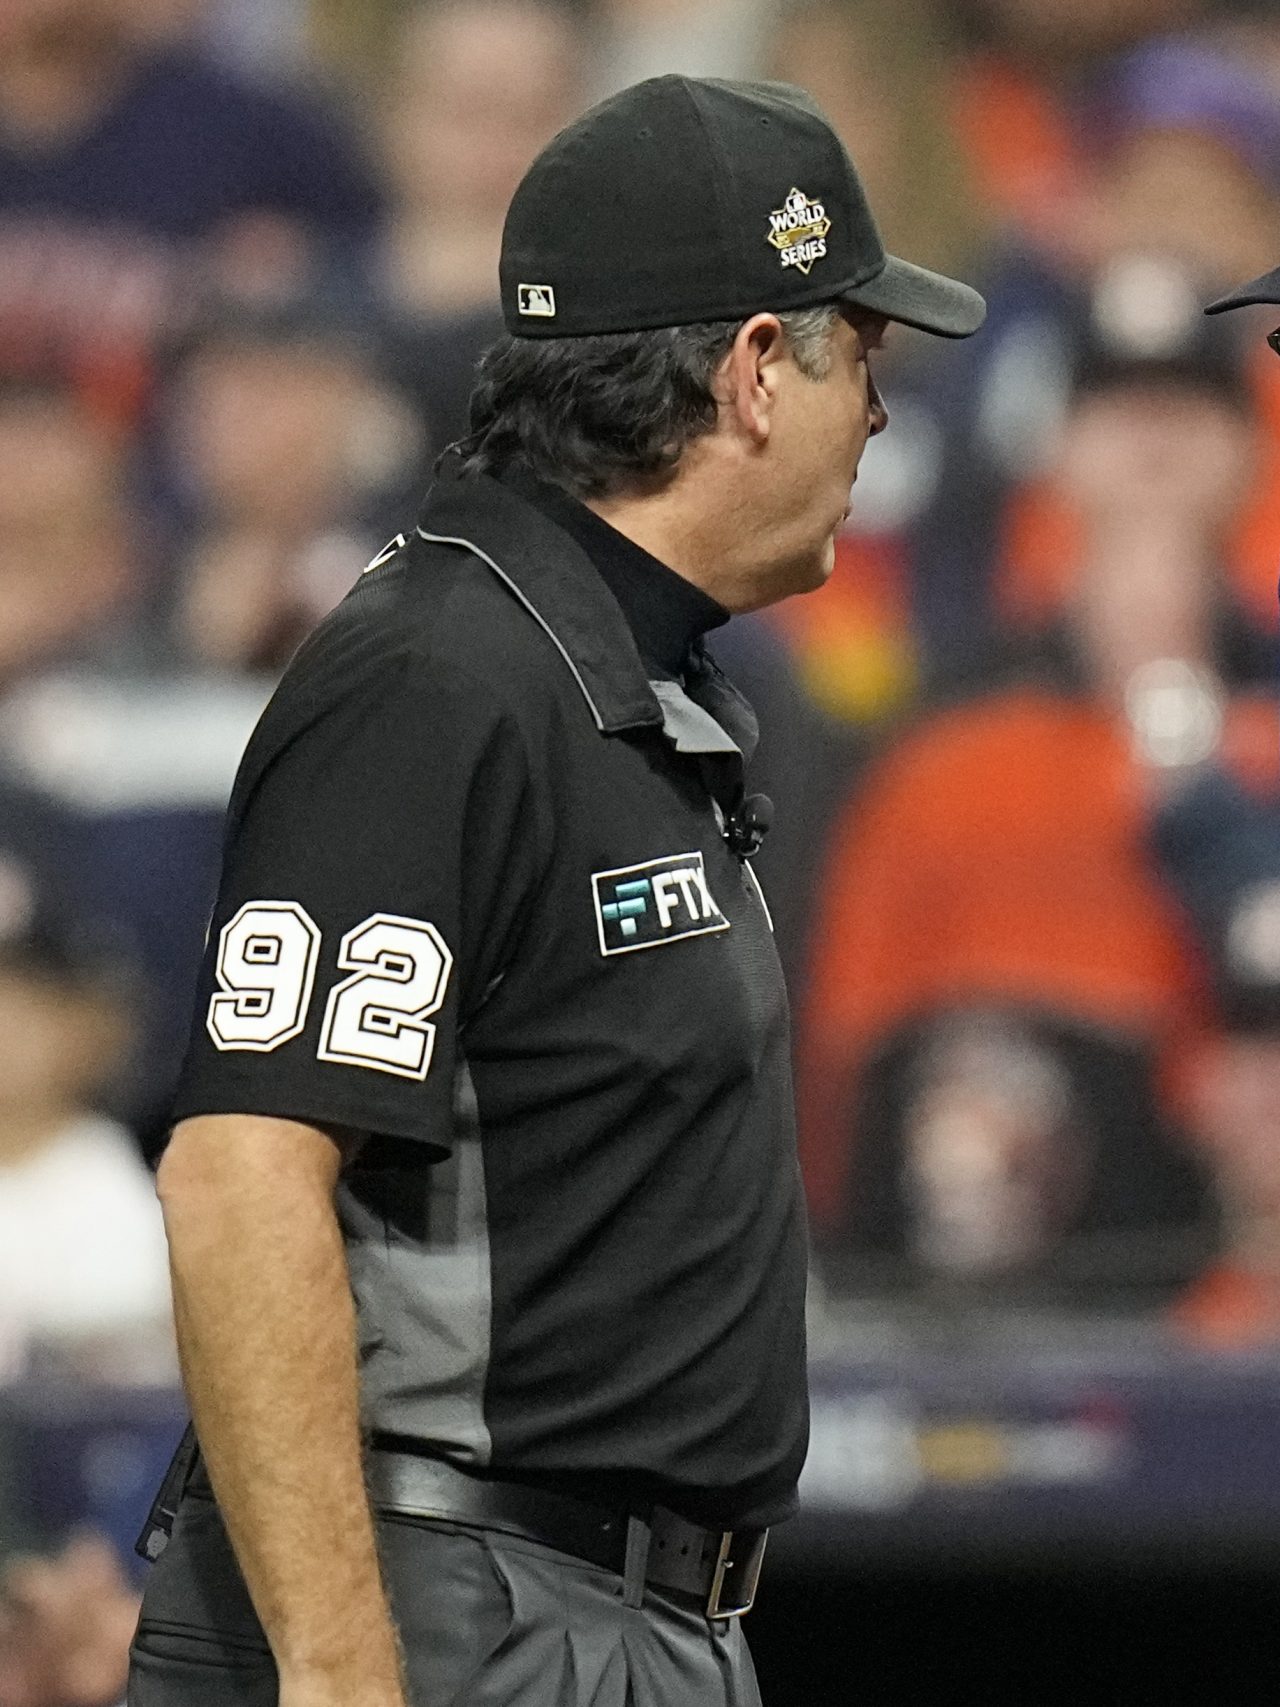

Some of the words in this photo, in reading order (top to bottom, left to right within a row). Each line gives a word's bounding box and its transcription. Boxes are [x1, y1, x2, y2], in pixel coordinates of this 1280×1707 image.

[769, 205, 825, 232] WORLD
[781, 238, 827, 267] SERIES
[206, 900, 453, 1081] 92
